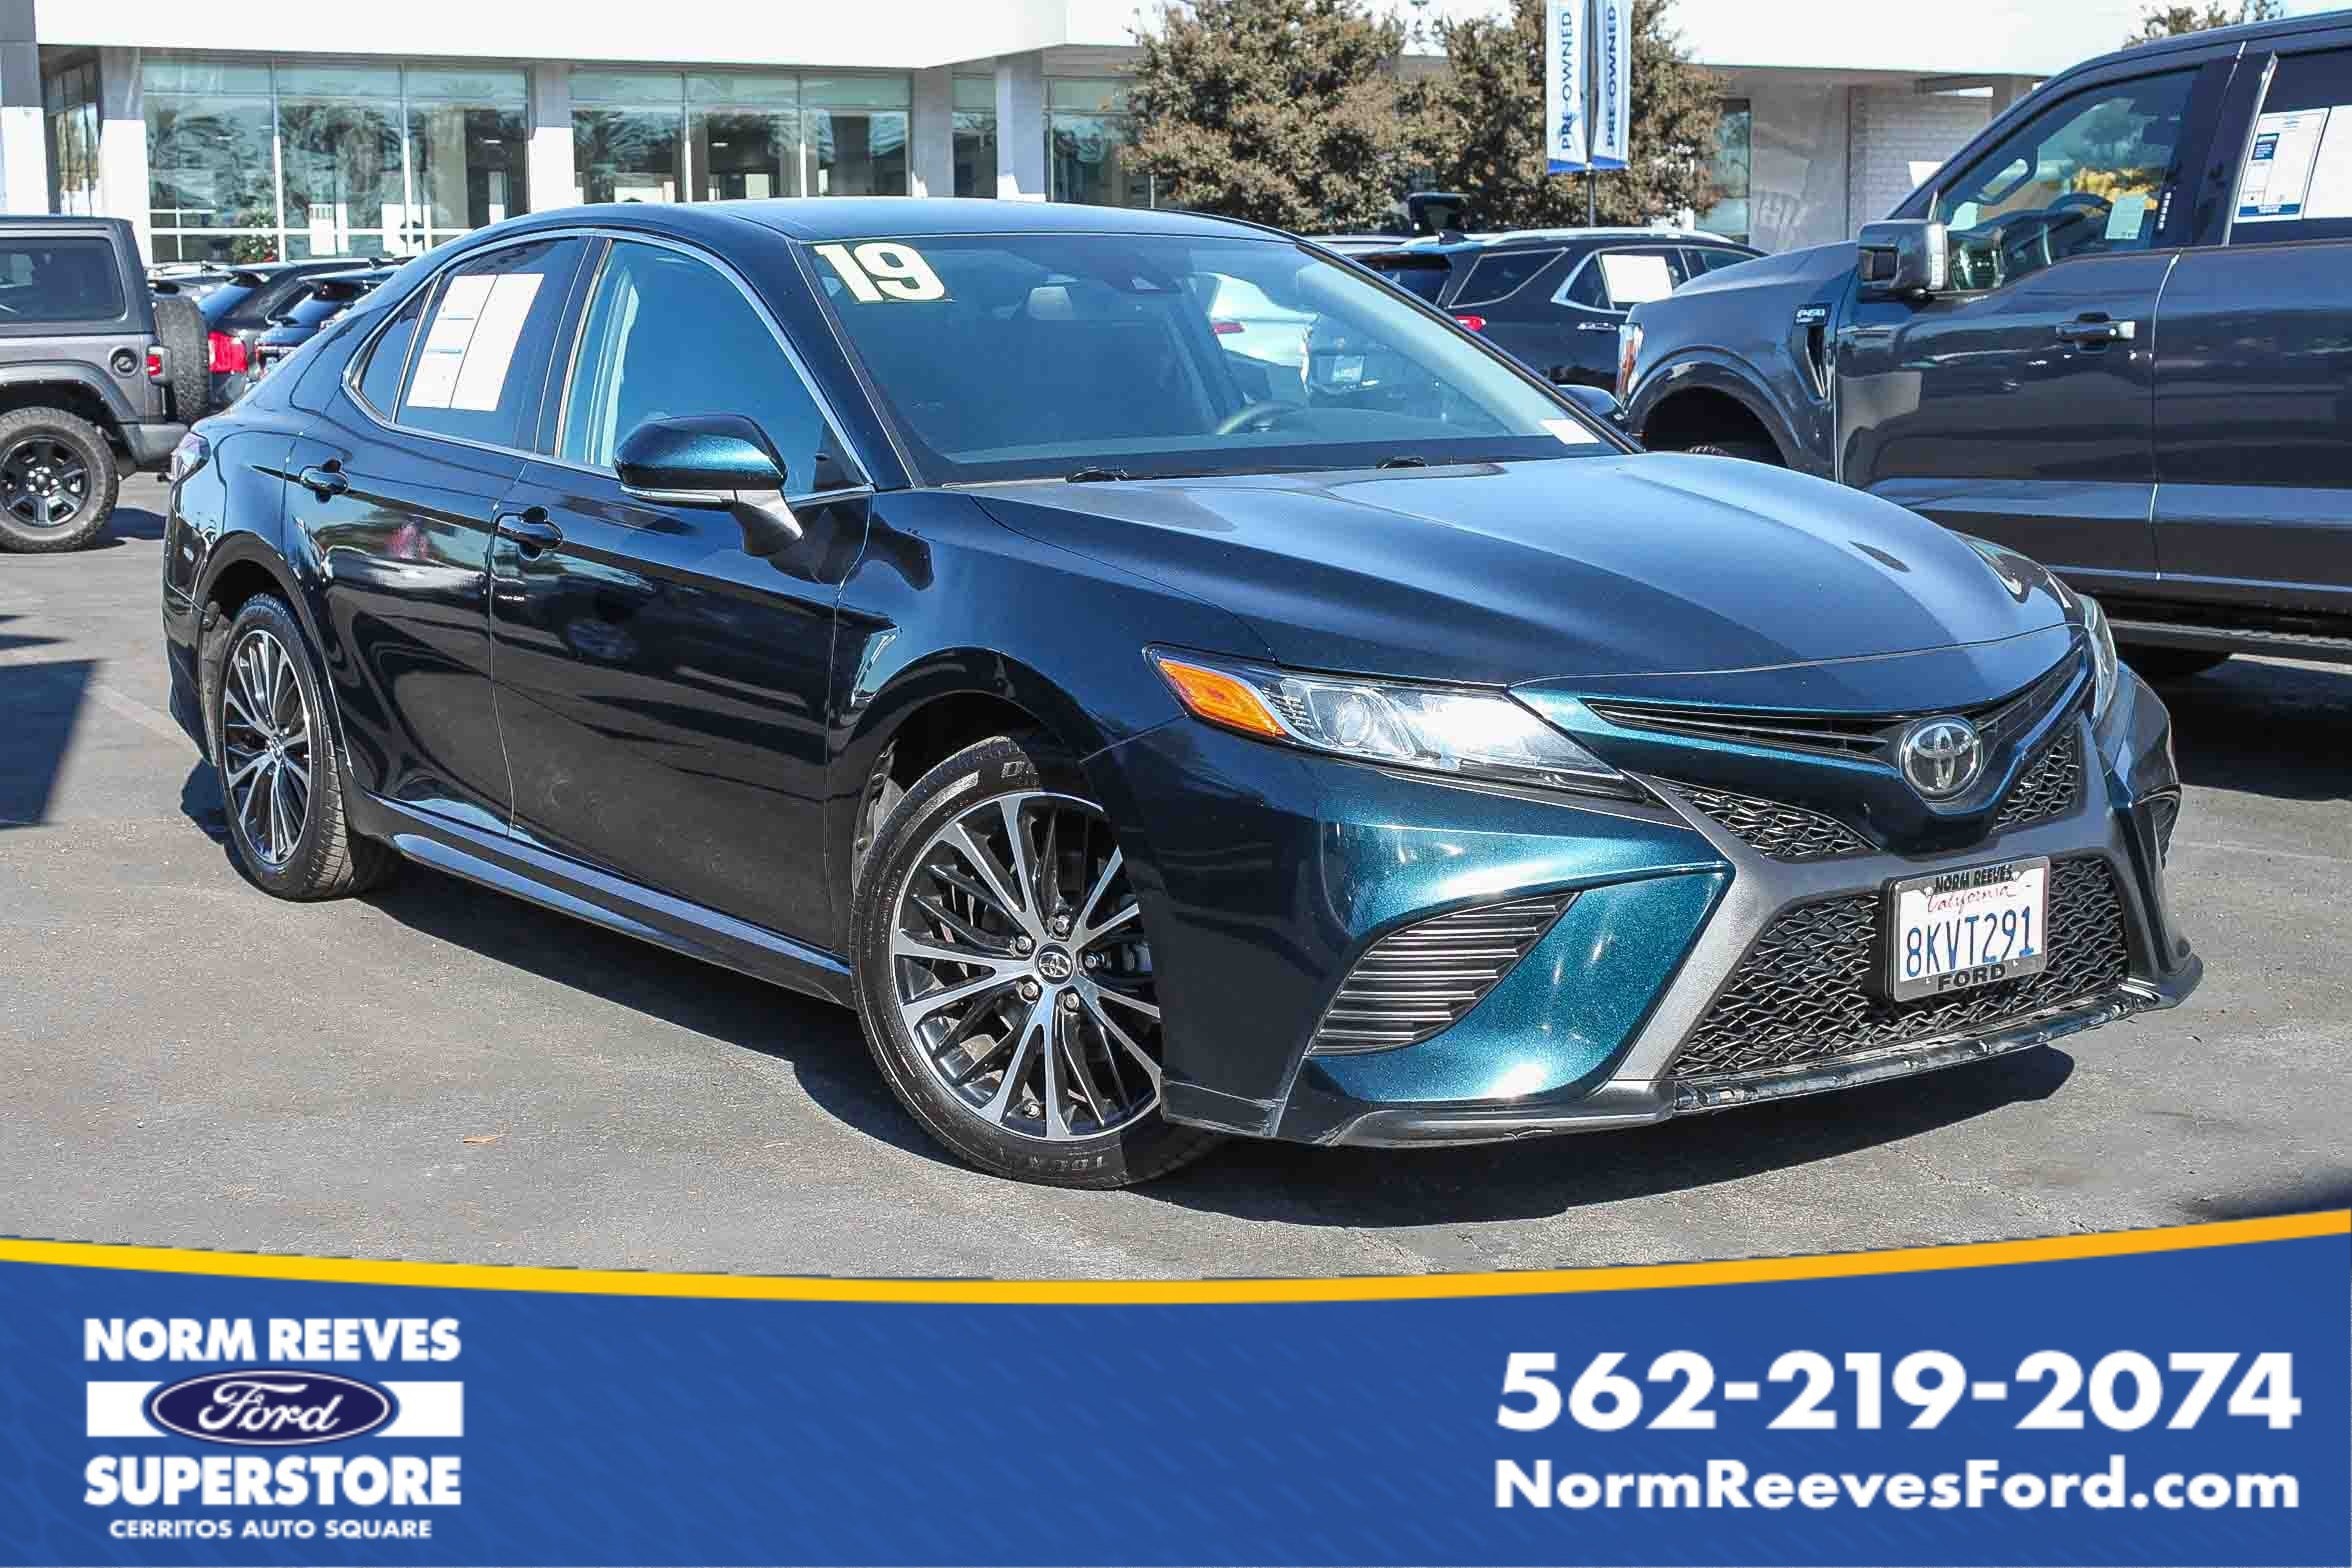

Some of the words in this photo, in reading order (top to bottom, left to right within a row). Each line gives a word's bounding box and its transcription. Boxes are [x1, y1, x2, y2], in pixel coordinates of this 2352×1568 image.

[1561, 12, 1573, 149] PRE-OWNED
[1607, 6, 1617, 146] PRE-OWNED
[813, 242, 945, 302] 19
[1927, 885, 2017, 913] California
[1935, 871, 1970, 893] NORM
[1973, 864, 2013, 885] REEVES
[1906, 905, 2035, 977] 8KVT291
[1937, 964, 2007, 991] FORD
